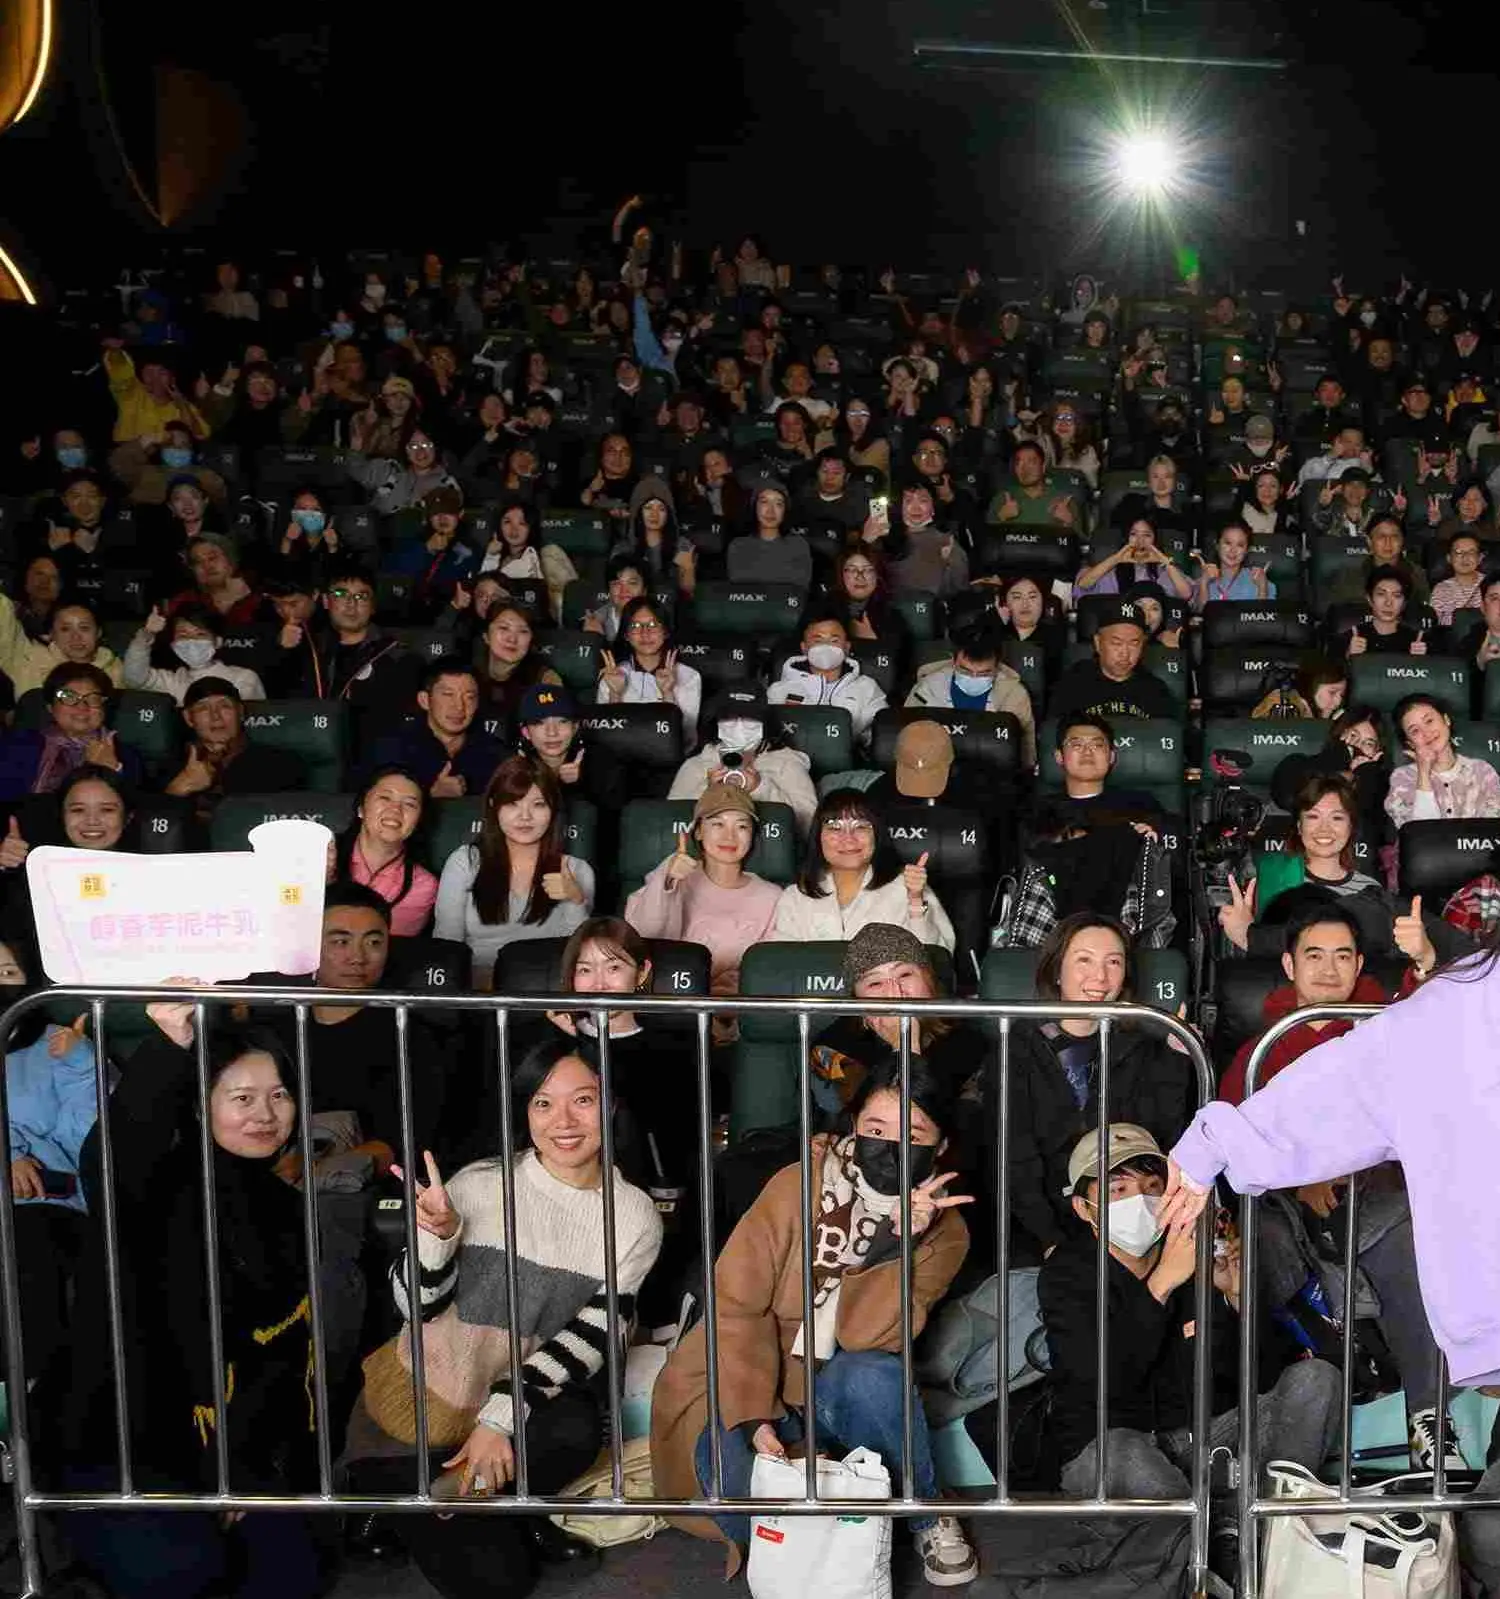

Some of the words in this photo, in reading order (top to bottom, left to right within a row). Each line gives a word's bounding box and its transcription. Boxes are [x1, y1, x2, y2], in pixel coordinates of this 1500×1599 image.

[1005, 534, 1040, 544] IMAX
[727, 593, 766, 603] IMAX
[1168, 608, 1181, 620] 13
[1239, 611, 1277, 623] IMAX
[1295, 613, 1307, 626] 12
[1421, 616, 1431, 629] 11
[222, 637, 256, 649] MAX
[429, 641, 444, 656] 18
[577, 645, 591, 658] 17
[730, 648, 743, 662] 16
[874, 655, 887, 668] 15
[1022, 656, 1034, 669] 14
[1166, 660, 1179, 674] 13
[1385, 667, 1428, 679] IMAX
[1449, 671, 1462, 684] 11
[139, 708, 155, 722] 19
[243, 714, 286, 727] MAX
[312, 714, 328, 730] 18
[484, 719, 497, 735] 17
[581, 718, 628, 731] MAX
[654, 720, 670, 735] 16
[824, 723, 840, 739] 15
[994, 726, 1009, 741] 14
[1160, 736, 1175, 751] 13
[1252, 734, 1301, 747] IMAX
[1487, 739, 1500, 754] 11
[149, 817, 168, 834] 18
[762, 822, 779, 840] 15
[887, 827, 928, 842] AX
[959, 828, 976, 846] 14
[1161, 833, 1178, 851] 13
[1264, 839, 1287, 853] IM
[426, 966, 446, 987] 16
[671, 970, 692, 991] 15
[1153, 980, 1175, 1001] 13
